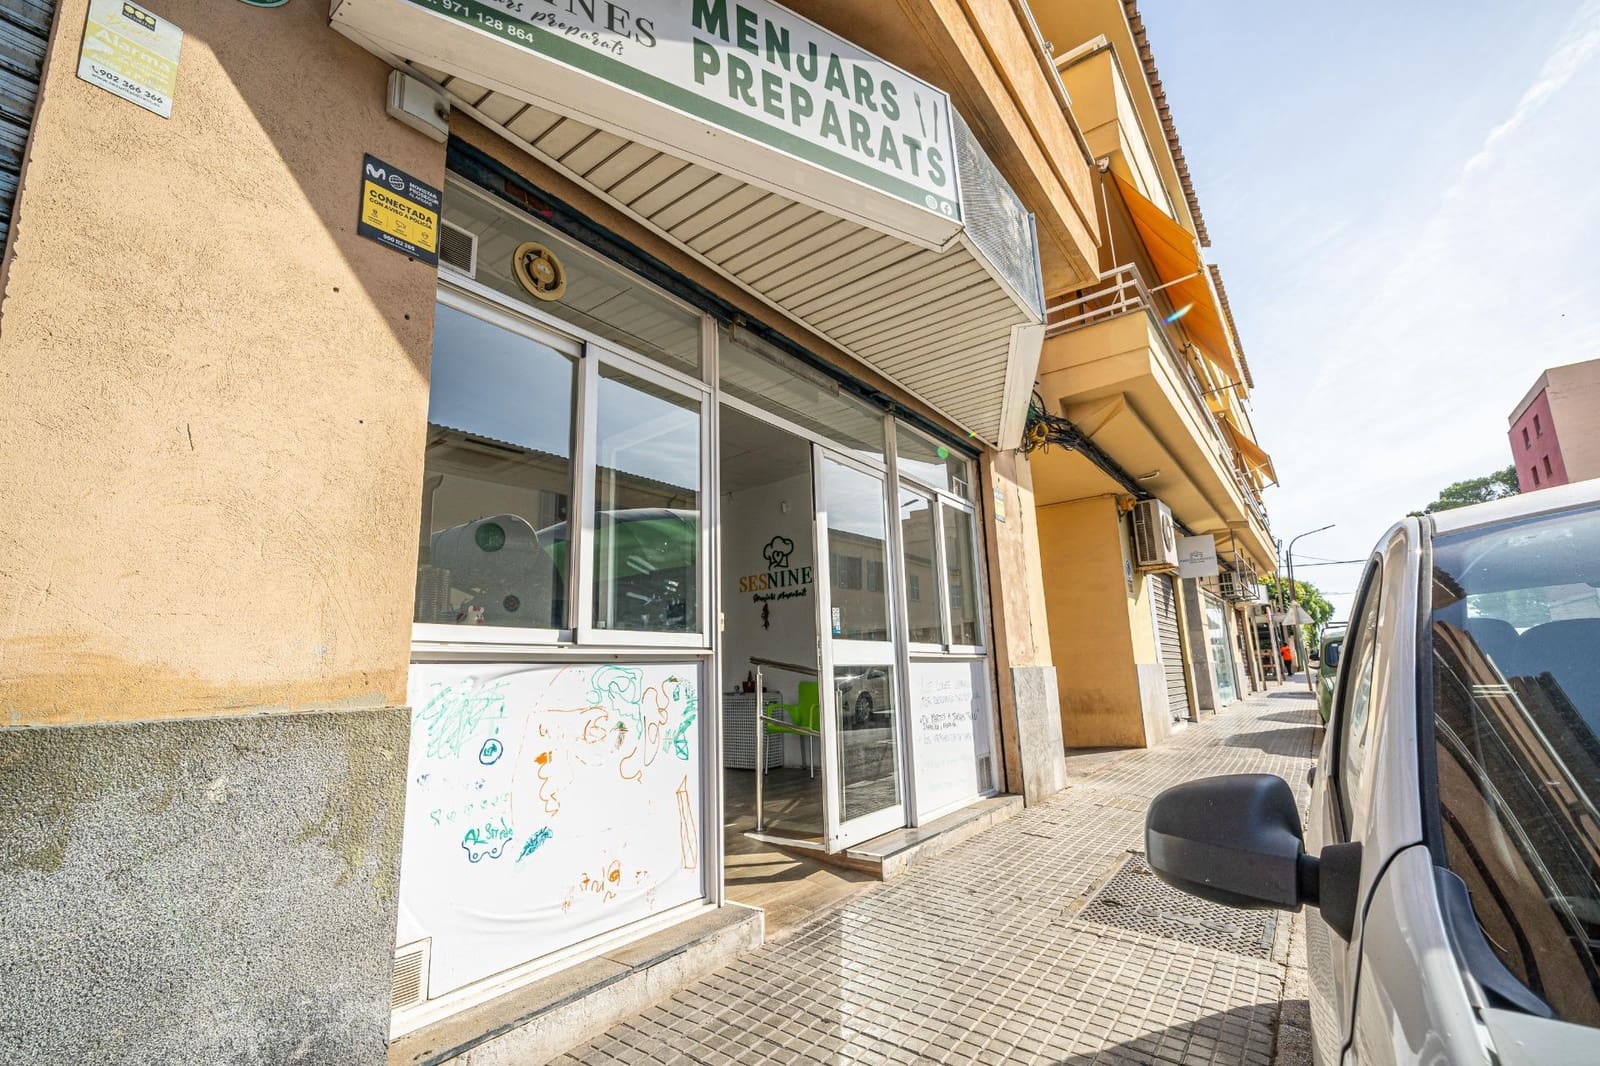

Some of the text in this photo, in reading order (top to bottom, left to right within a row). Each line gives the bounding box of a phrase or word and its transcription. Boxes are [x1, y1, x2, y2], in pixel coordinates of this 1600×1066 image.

[443, 0, 534, 43] 971 128 864
[530, 11, 625, 56] preparats
[692, 0, 900, 121] MENJARS
[99, 68, 119, 83] 902
[122, 79, 141, 94] 366
[144, 90, 163, 104] 366
[692, 37, 946, 188] PREPARATS
[369, 197, 384, 208] CON
[384, 203, 403, 216] AVISO
[369, 189, 433, 225] CONECTADA
